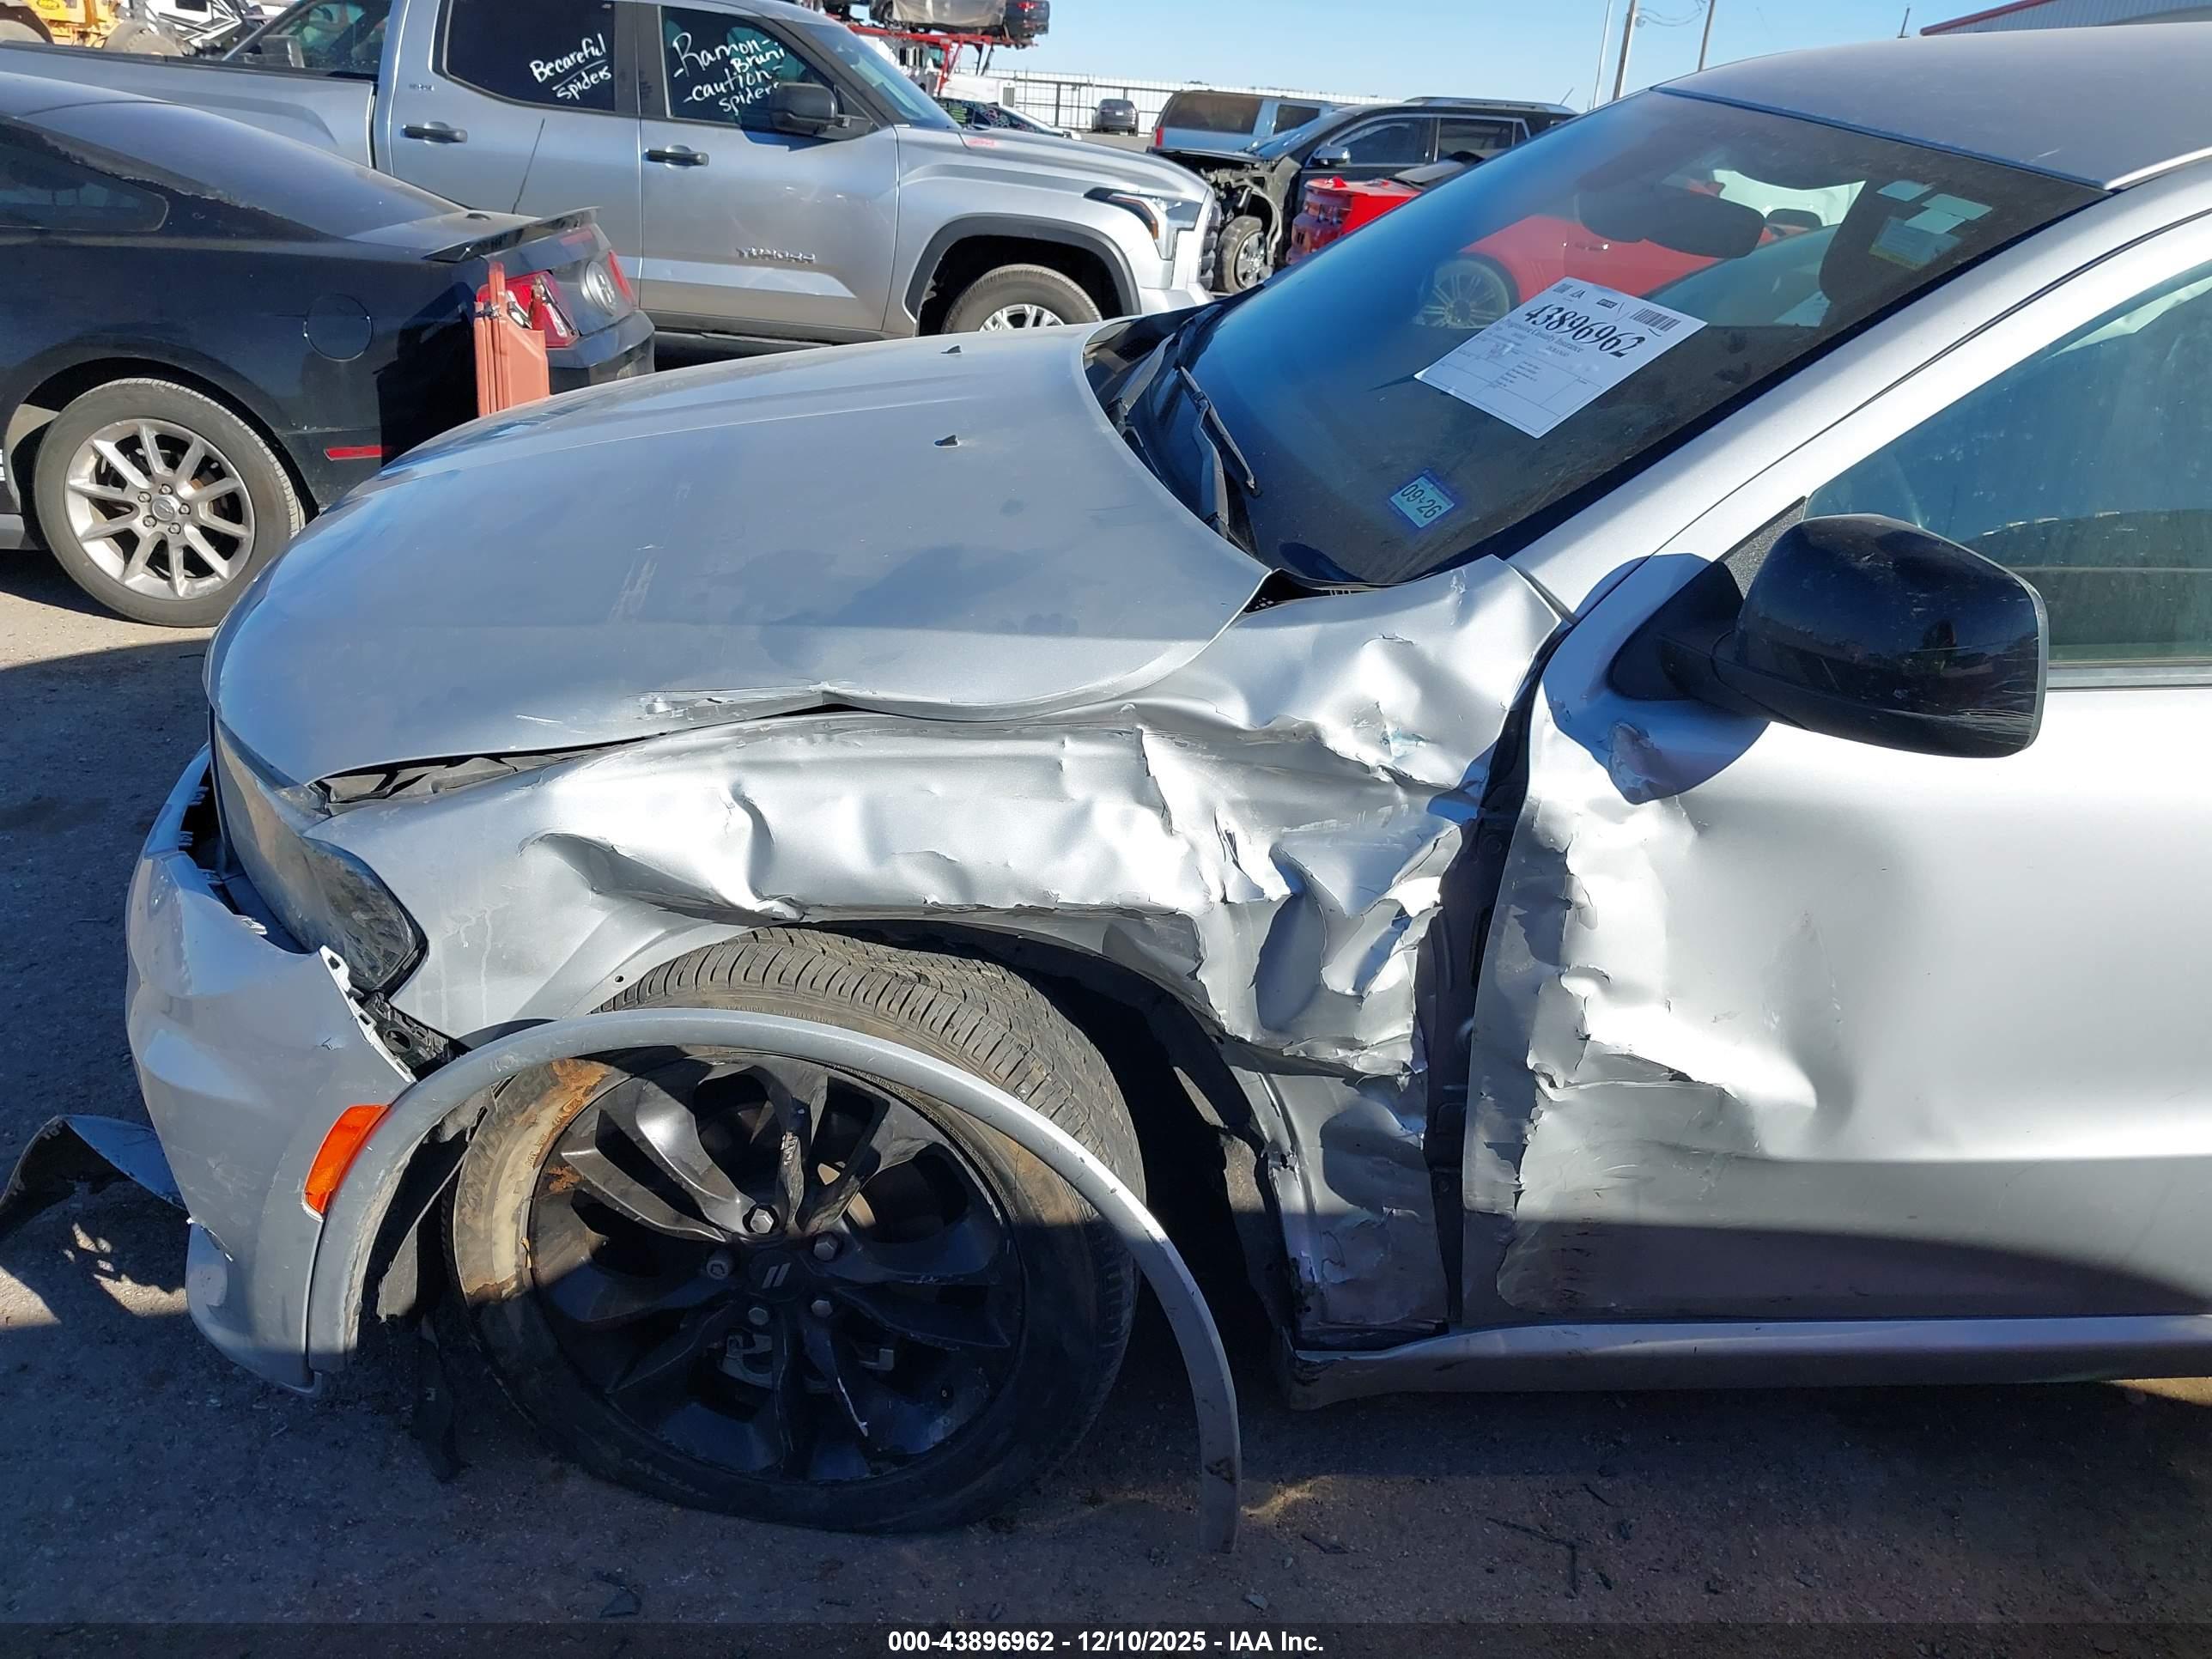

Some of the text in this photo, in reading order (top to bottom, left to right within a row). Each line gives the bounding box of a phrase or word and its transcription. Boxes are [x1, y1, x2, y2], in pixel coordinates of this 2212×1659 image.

[529, 33, 606, 82] Becareful
[556, 65, 611, 100] spiders
[1524, 303, 1645, 359] 43896962
